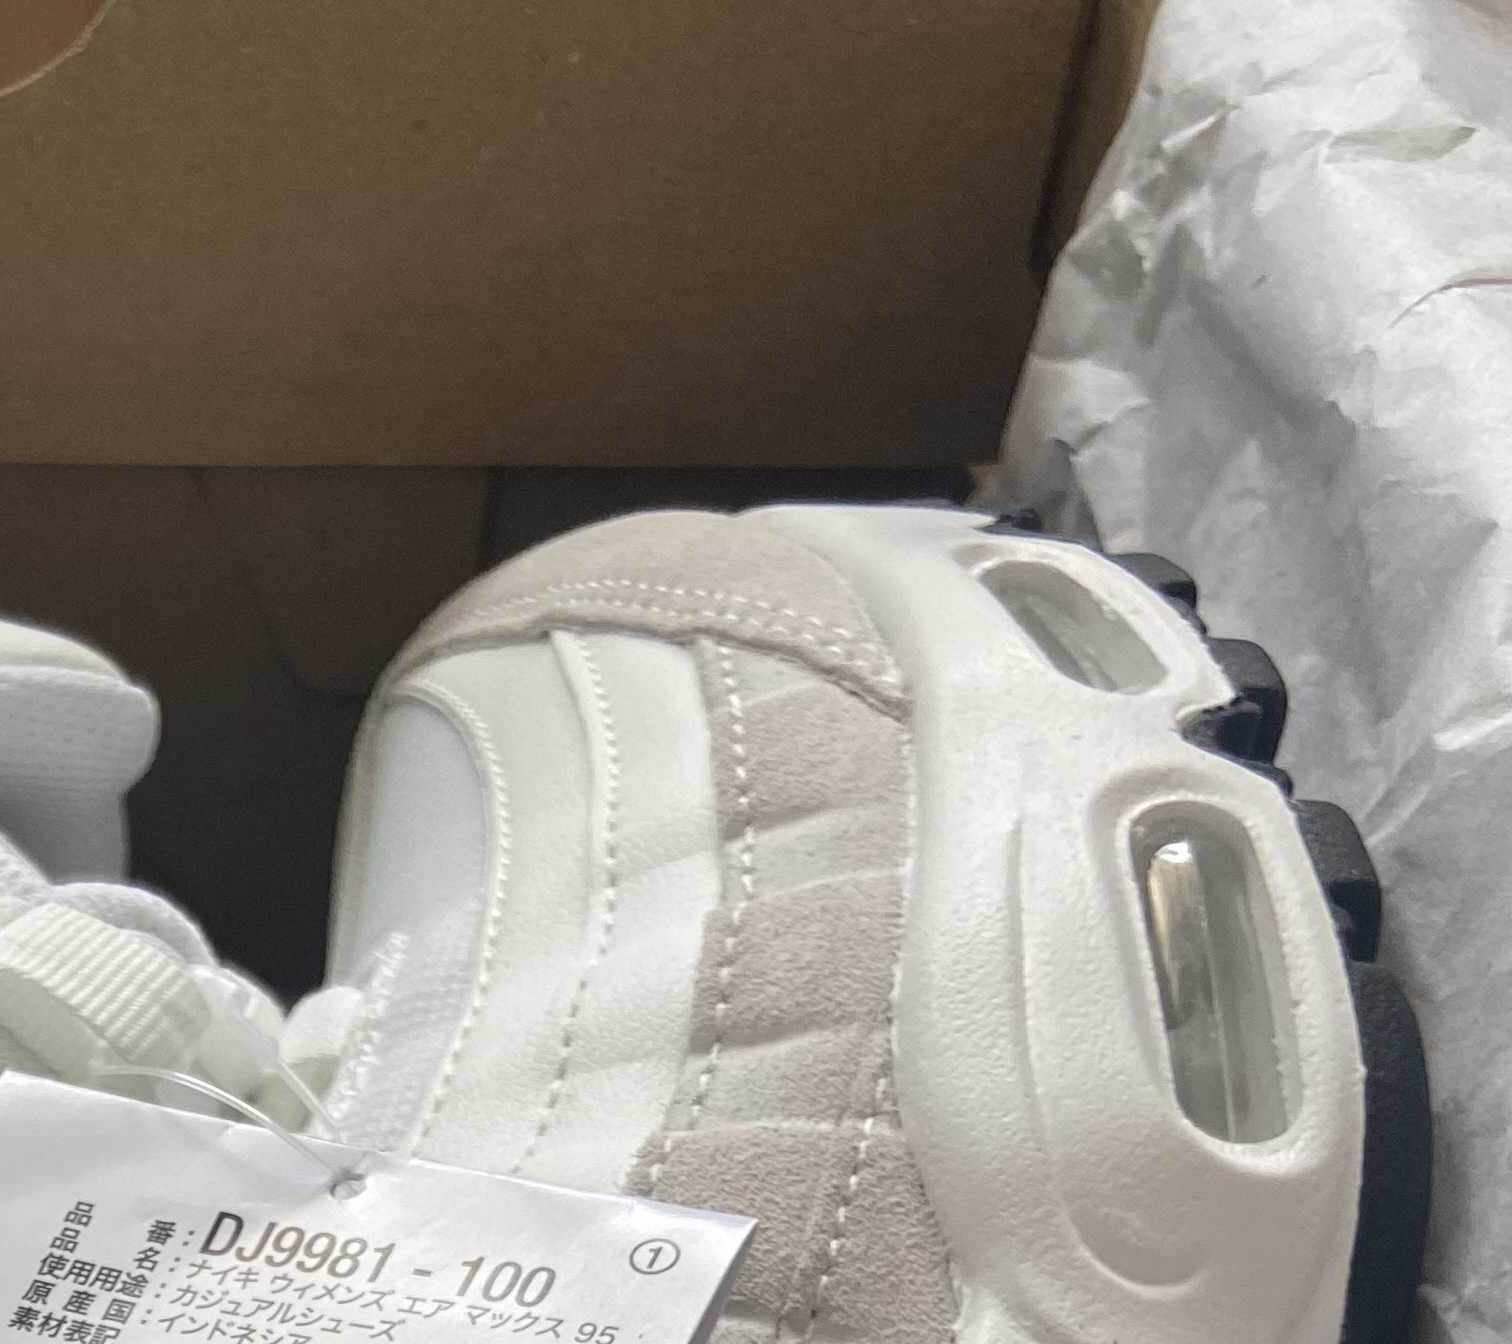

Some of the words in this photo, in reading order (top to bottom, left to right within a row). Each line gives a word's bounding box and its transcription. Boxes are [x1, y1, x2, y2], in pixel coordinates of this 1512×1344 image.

[187, 1258, 260, 1287] ナイキ
[271, 1272, 394, 1311] ウィメンズ
[398, 1294, 459, 1321] エア
[465, 1304, 564, 1339] マックス
[199, 1210, 398, 1284] DJ9981
[454, 1255, 557, 1309] 100
[169, 1284, 408, 1343] カジュアルシューズ
